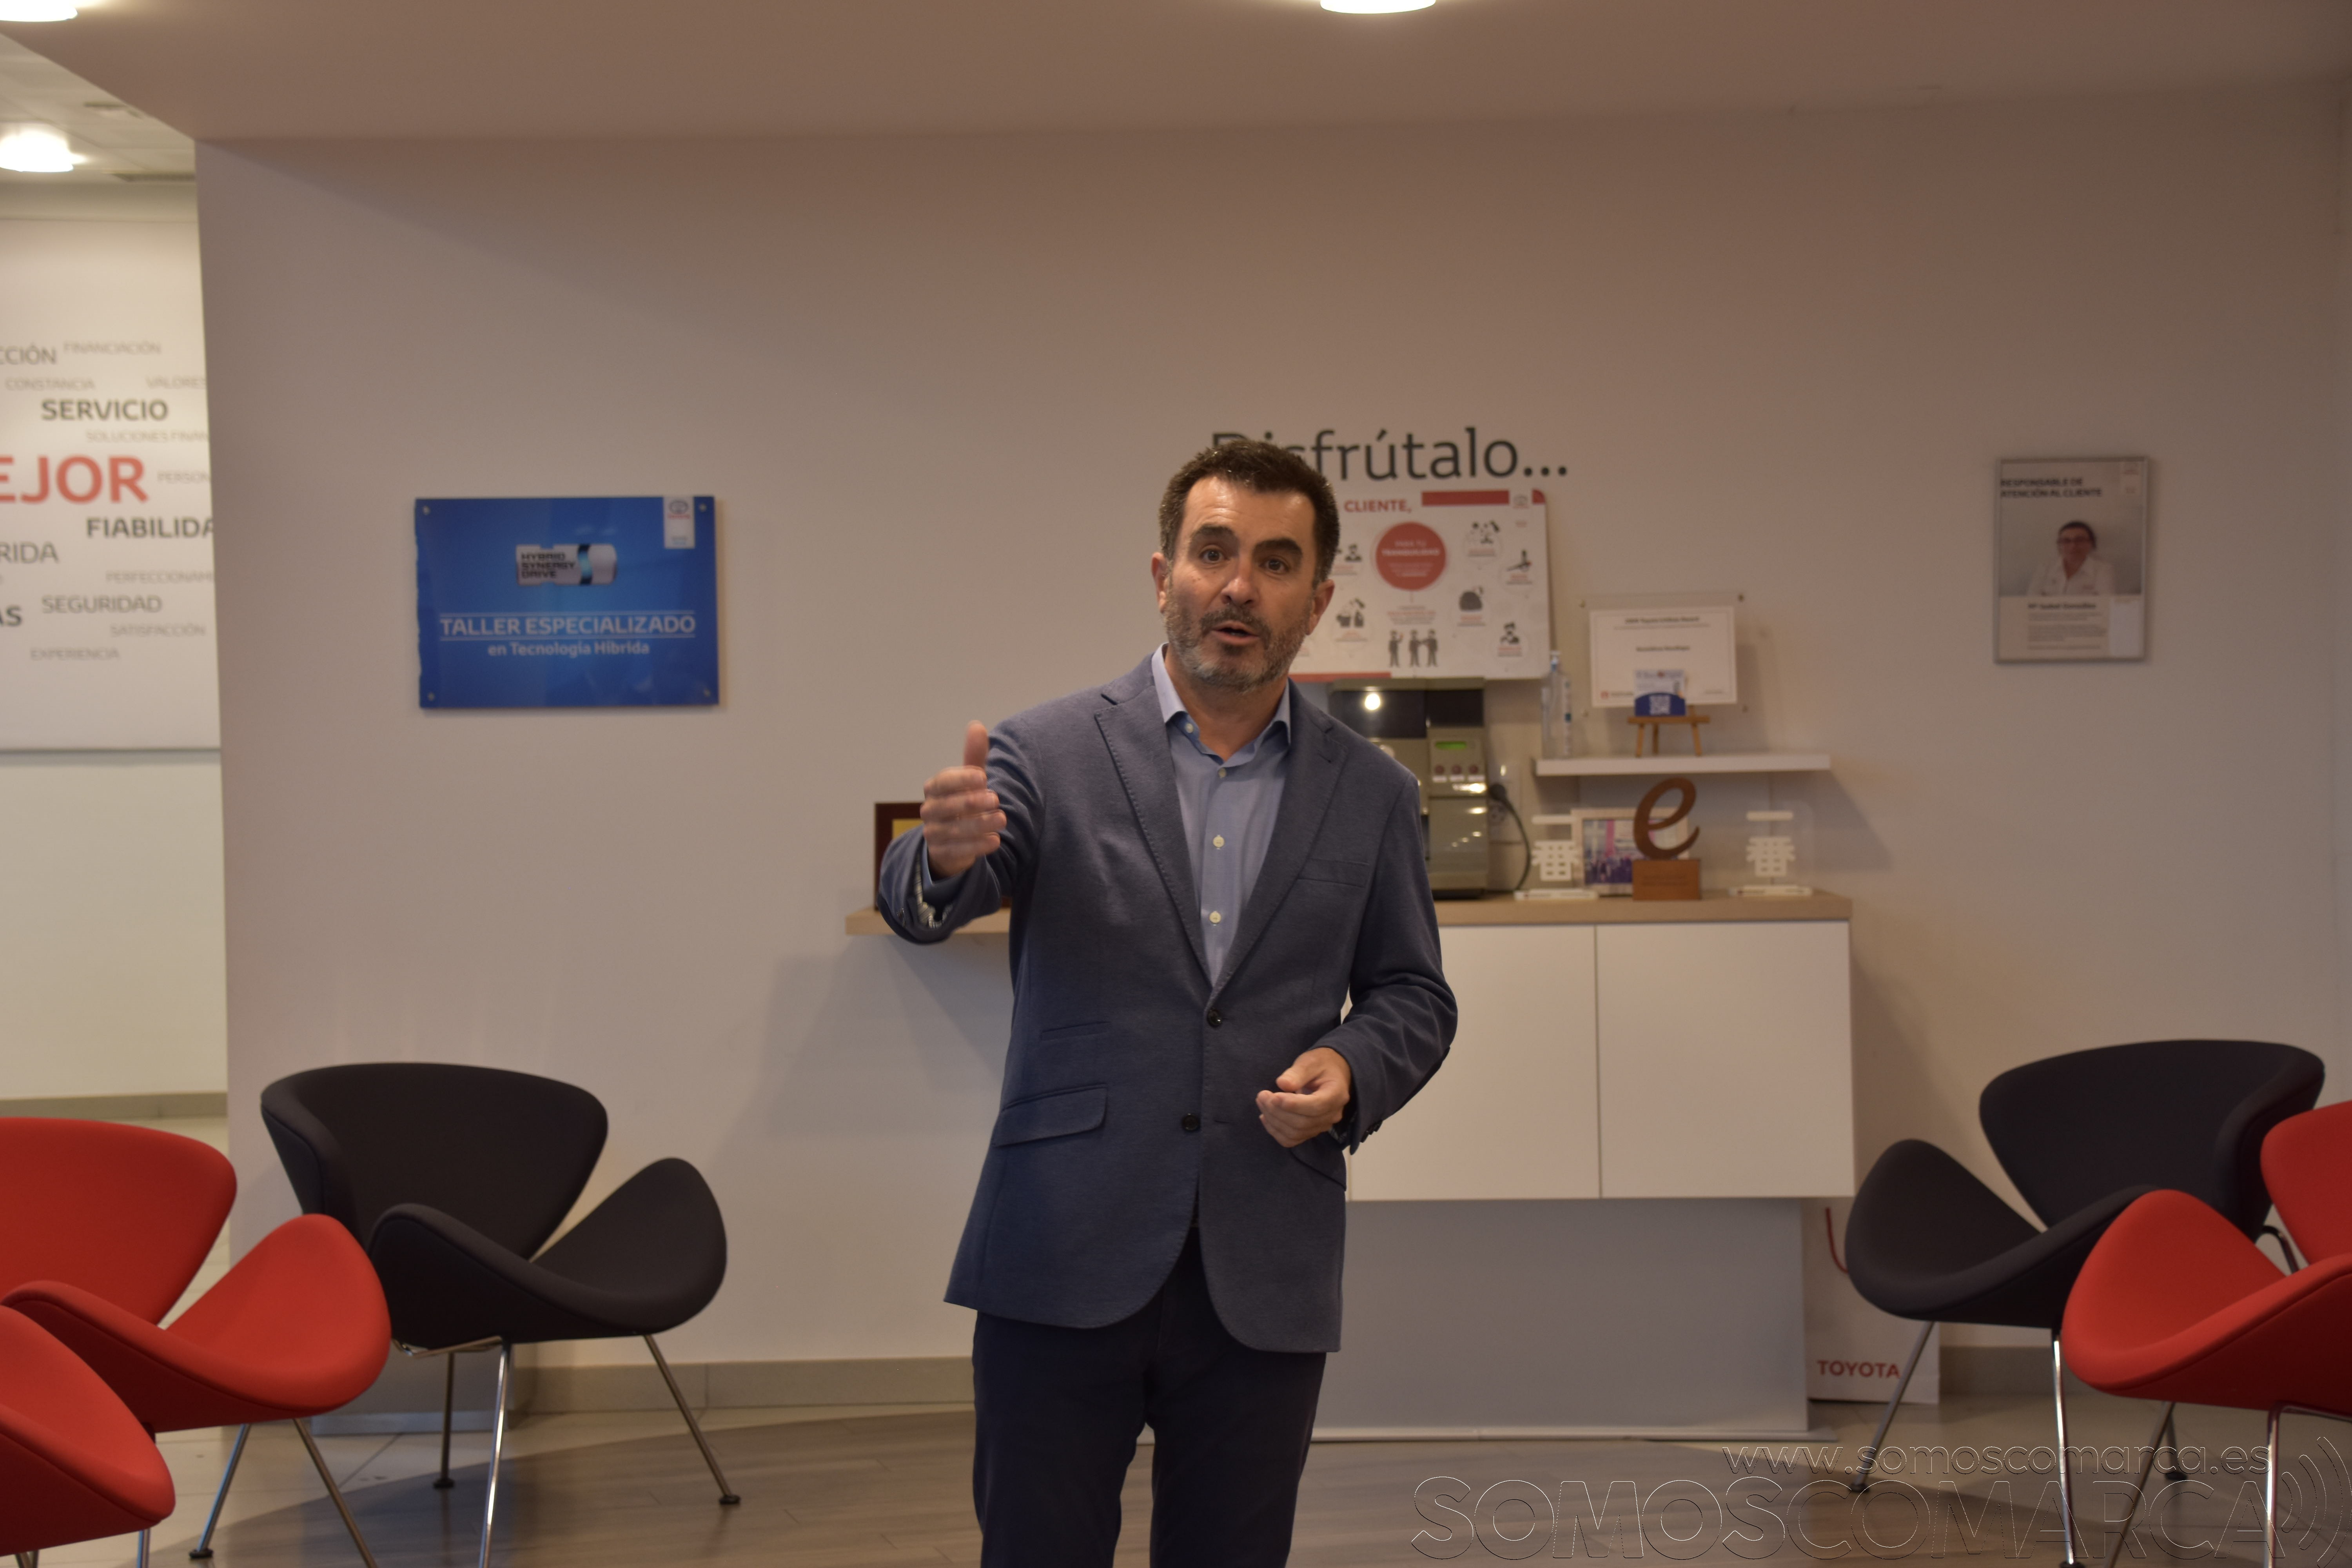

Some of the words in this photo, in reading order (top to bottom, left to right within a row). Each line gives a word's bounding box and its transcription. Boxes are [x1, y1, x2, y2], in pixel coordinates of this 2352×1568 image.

[5, 377, 95, 390] CONSTANCIA
[42, 399, 169, 421] SERVICIO
[85, 431, 167, 443] SOLUCIONES
[1212, 426, 1567, 481] frútalo...
[0, 455, 149, 504] EJOR
[1344, 499, 1412, 513] CLIENTE,
[42, 595, 162, 613] SEGURIDAD
[0, 605, 22, 627] S
[440, 618, 521, 636] TALLER
[525, 615, 695, 634] ESPECIALIZADO
[31, 647, 119, 661] EXPERIENCIA
[488, 645, 507, 656] en
[1817, 1359, 1900, 1379] TOYOTA
